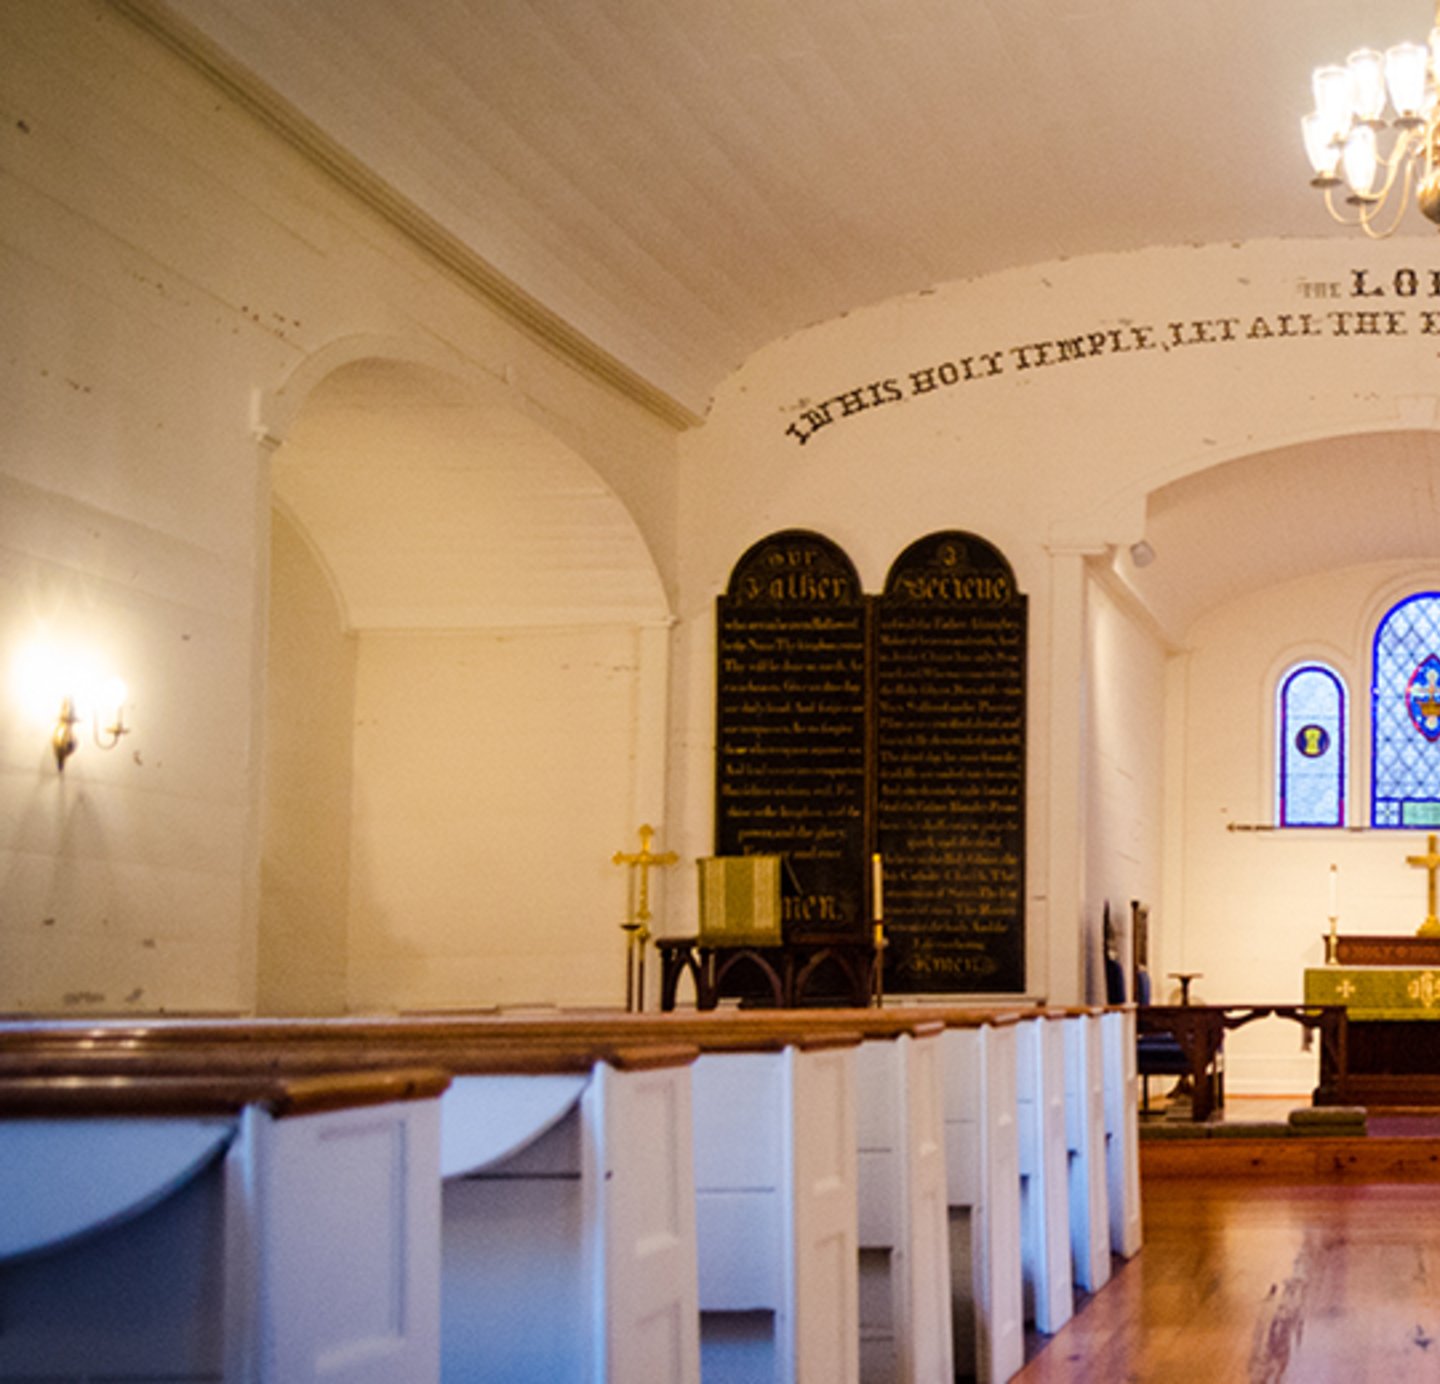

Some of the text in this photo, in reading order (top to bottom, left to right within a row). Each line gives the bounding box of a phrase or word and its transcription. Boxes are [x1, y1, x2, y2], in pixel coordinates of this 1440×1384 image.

[1300, 281, 1341, 298] THE
[784, 400, 834, 446] IN
[838, 378, 903, 417] HIS
[908, 351, 1004, 396] HOLY
[1168, 318, 1238, 348] LET
[1245, 313, 1322, 340] ALL
[1327, 310, 1409, 337] THE
